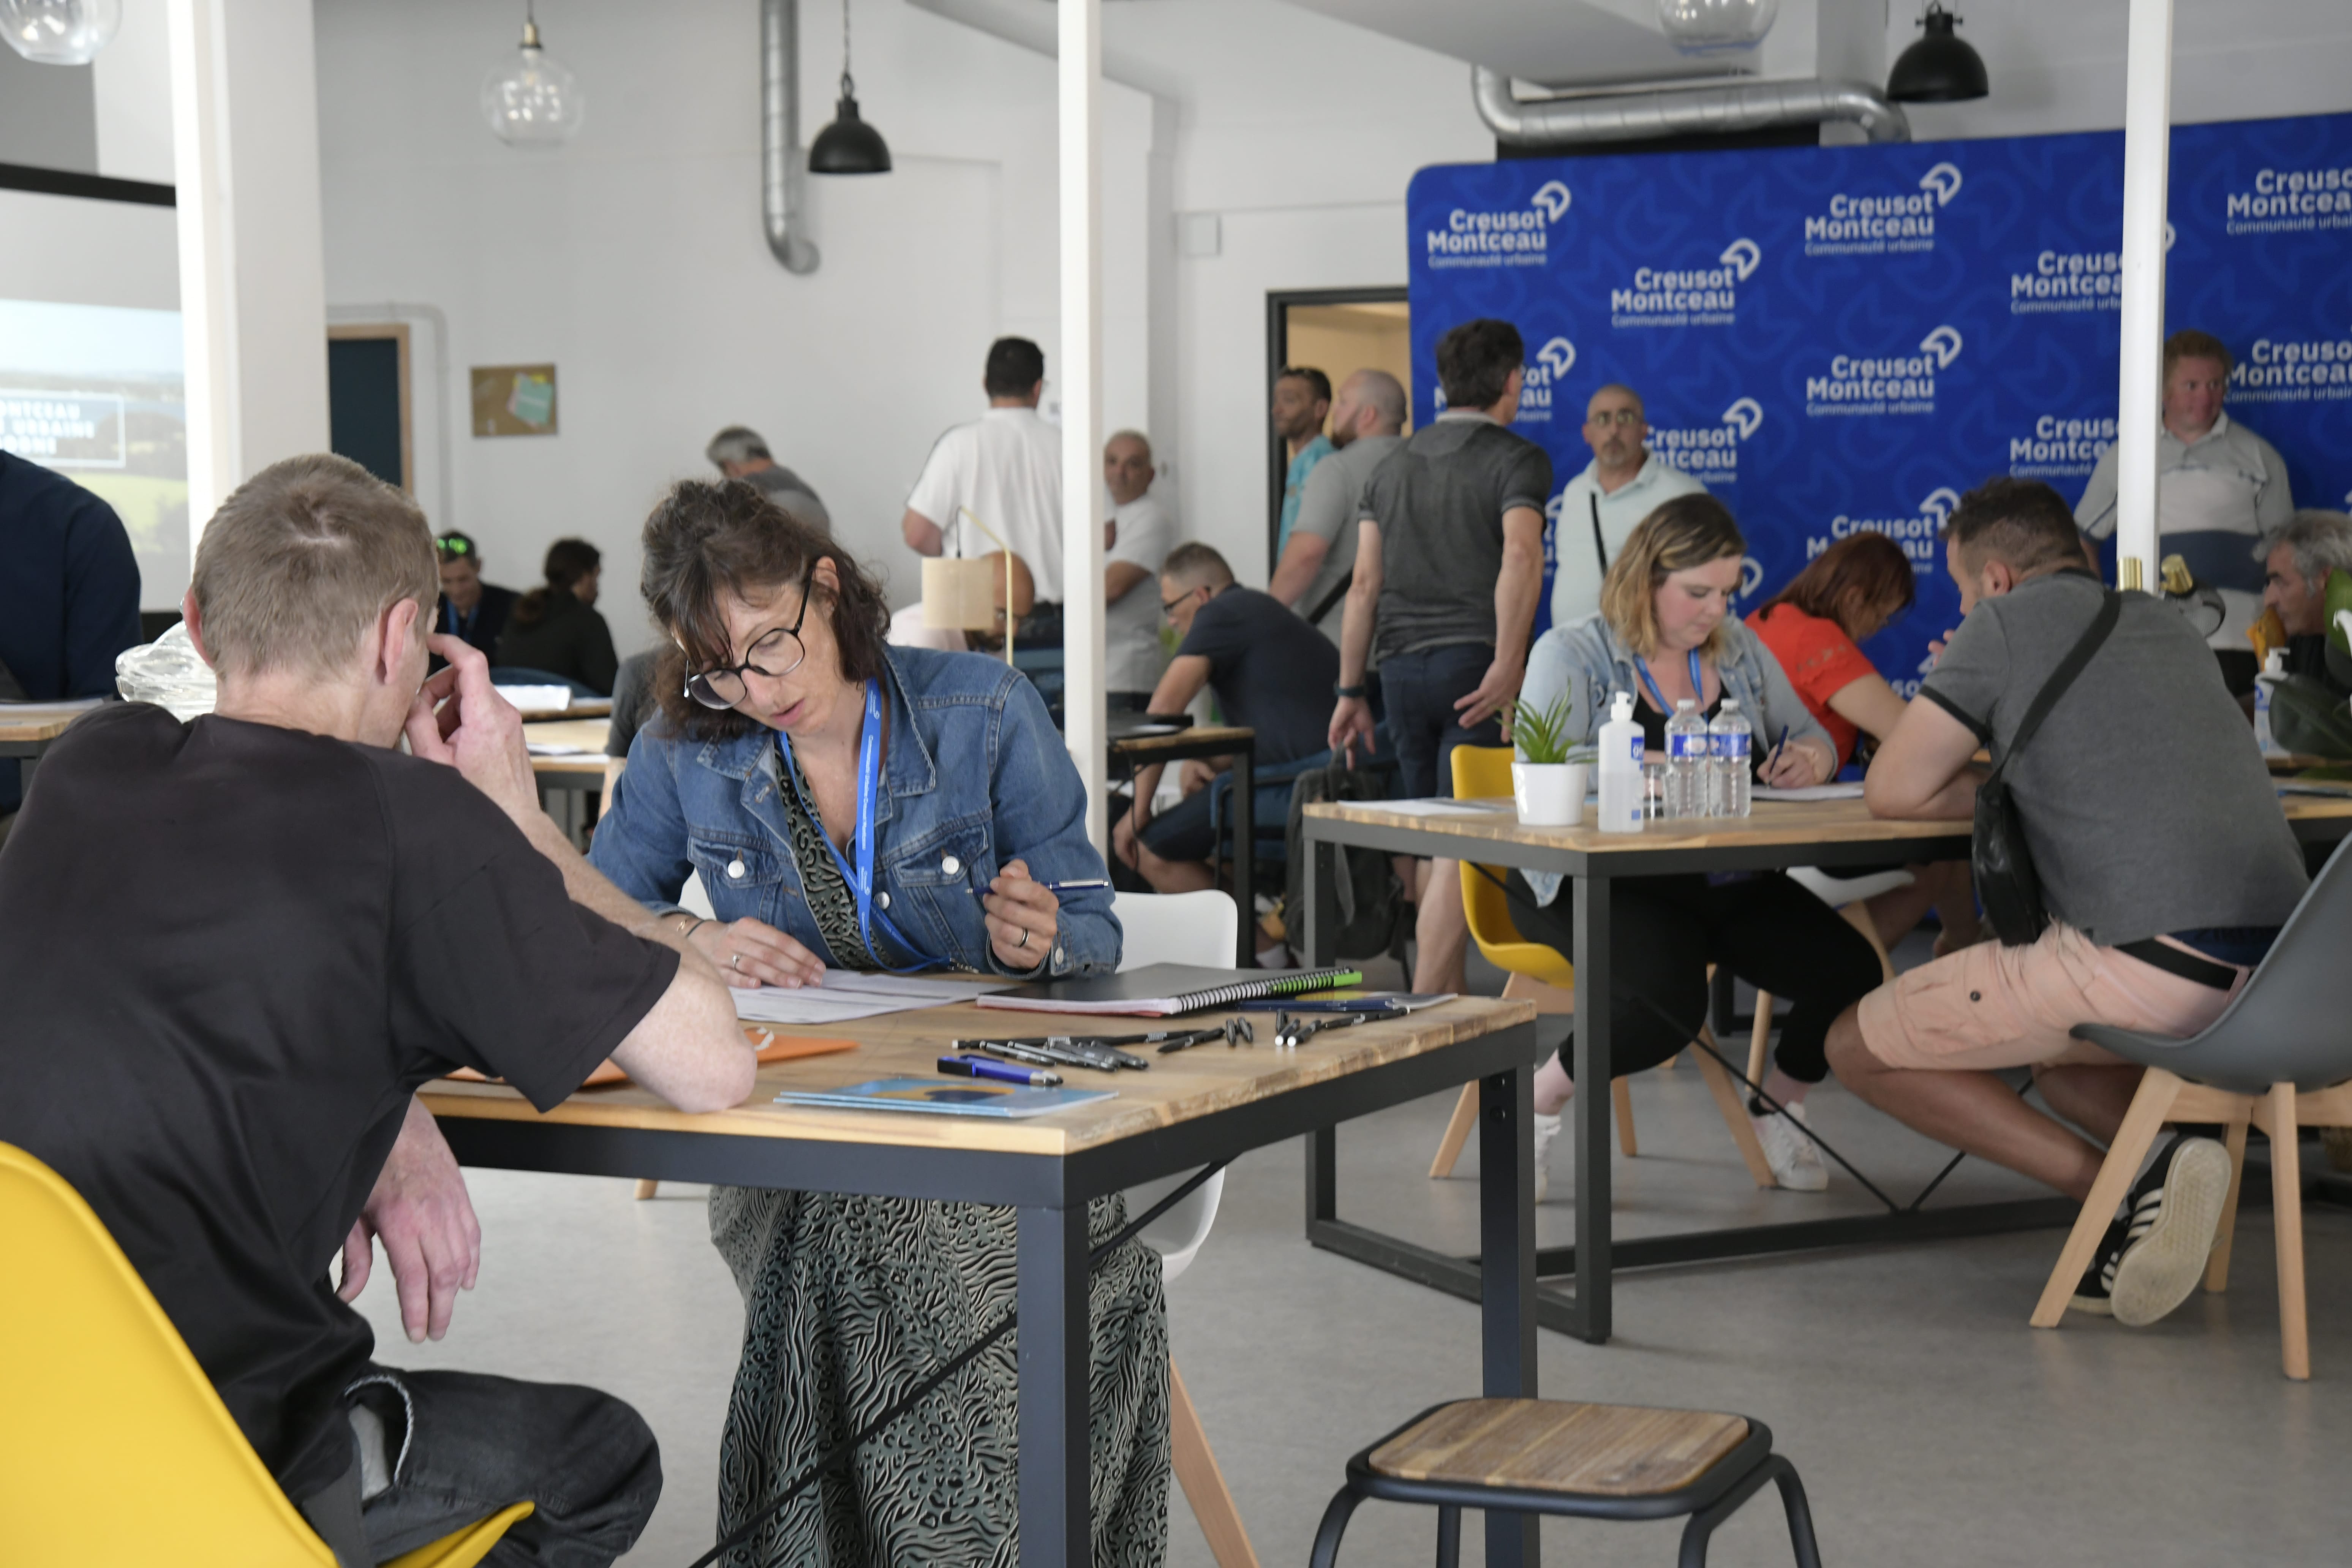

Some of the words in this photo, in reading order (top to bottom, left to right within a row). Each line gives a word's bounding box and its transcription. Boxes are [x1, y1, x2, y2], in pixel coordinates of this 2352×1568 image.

[2256, 168, 2352, 195] Creuso
[1830, 191, 1933, 218] Creusot
[2227, 192, 2352, 218] Montcea
[1449, 208, 1545, 232] Creusot
[1805, 215, 1934, 240] Montceau
[2227, 214, 2315, 236] Communauté
[1427, 229, 1547, 254] Montceau
[1805, 240, 1886, 256] Communauté
[1887, 239, 1934, 253] urbaine
[1428, 254, 1501, 270] Communauté
[1504, 253, 1547, 266] urbaine
[2037, 250, 2122, 276] Creus
[1635, 267, 1733, 291] Creusot
[2011, 272, 2122, 298] Montcea
[1611, 288, 1735, 312] Montceau
[2011, 297, 2094, 314] Communauté
[1612, 313, 1688, 329] Communauté
[1690, 312, 1735, 325] urbaine
[2252, 338, 2352, 364] Creuso
[1831, 354, 1933, 379] Creusot
[2226, 362, 2352, 387] Montcea
[1807, 377, 1934, 401] Montceau
[1807, 401, 1886, 417] Communauté
[1888, 400, 1934, 414] urbaine
[2036, 415, 2119, 441] Creus
[1653, 447, 1737, 469] ntceau
[2010, 437, 2108, 463] Montce
